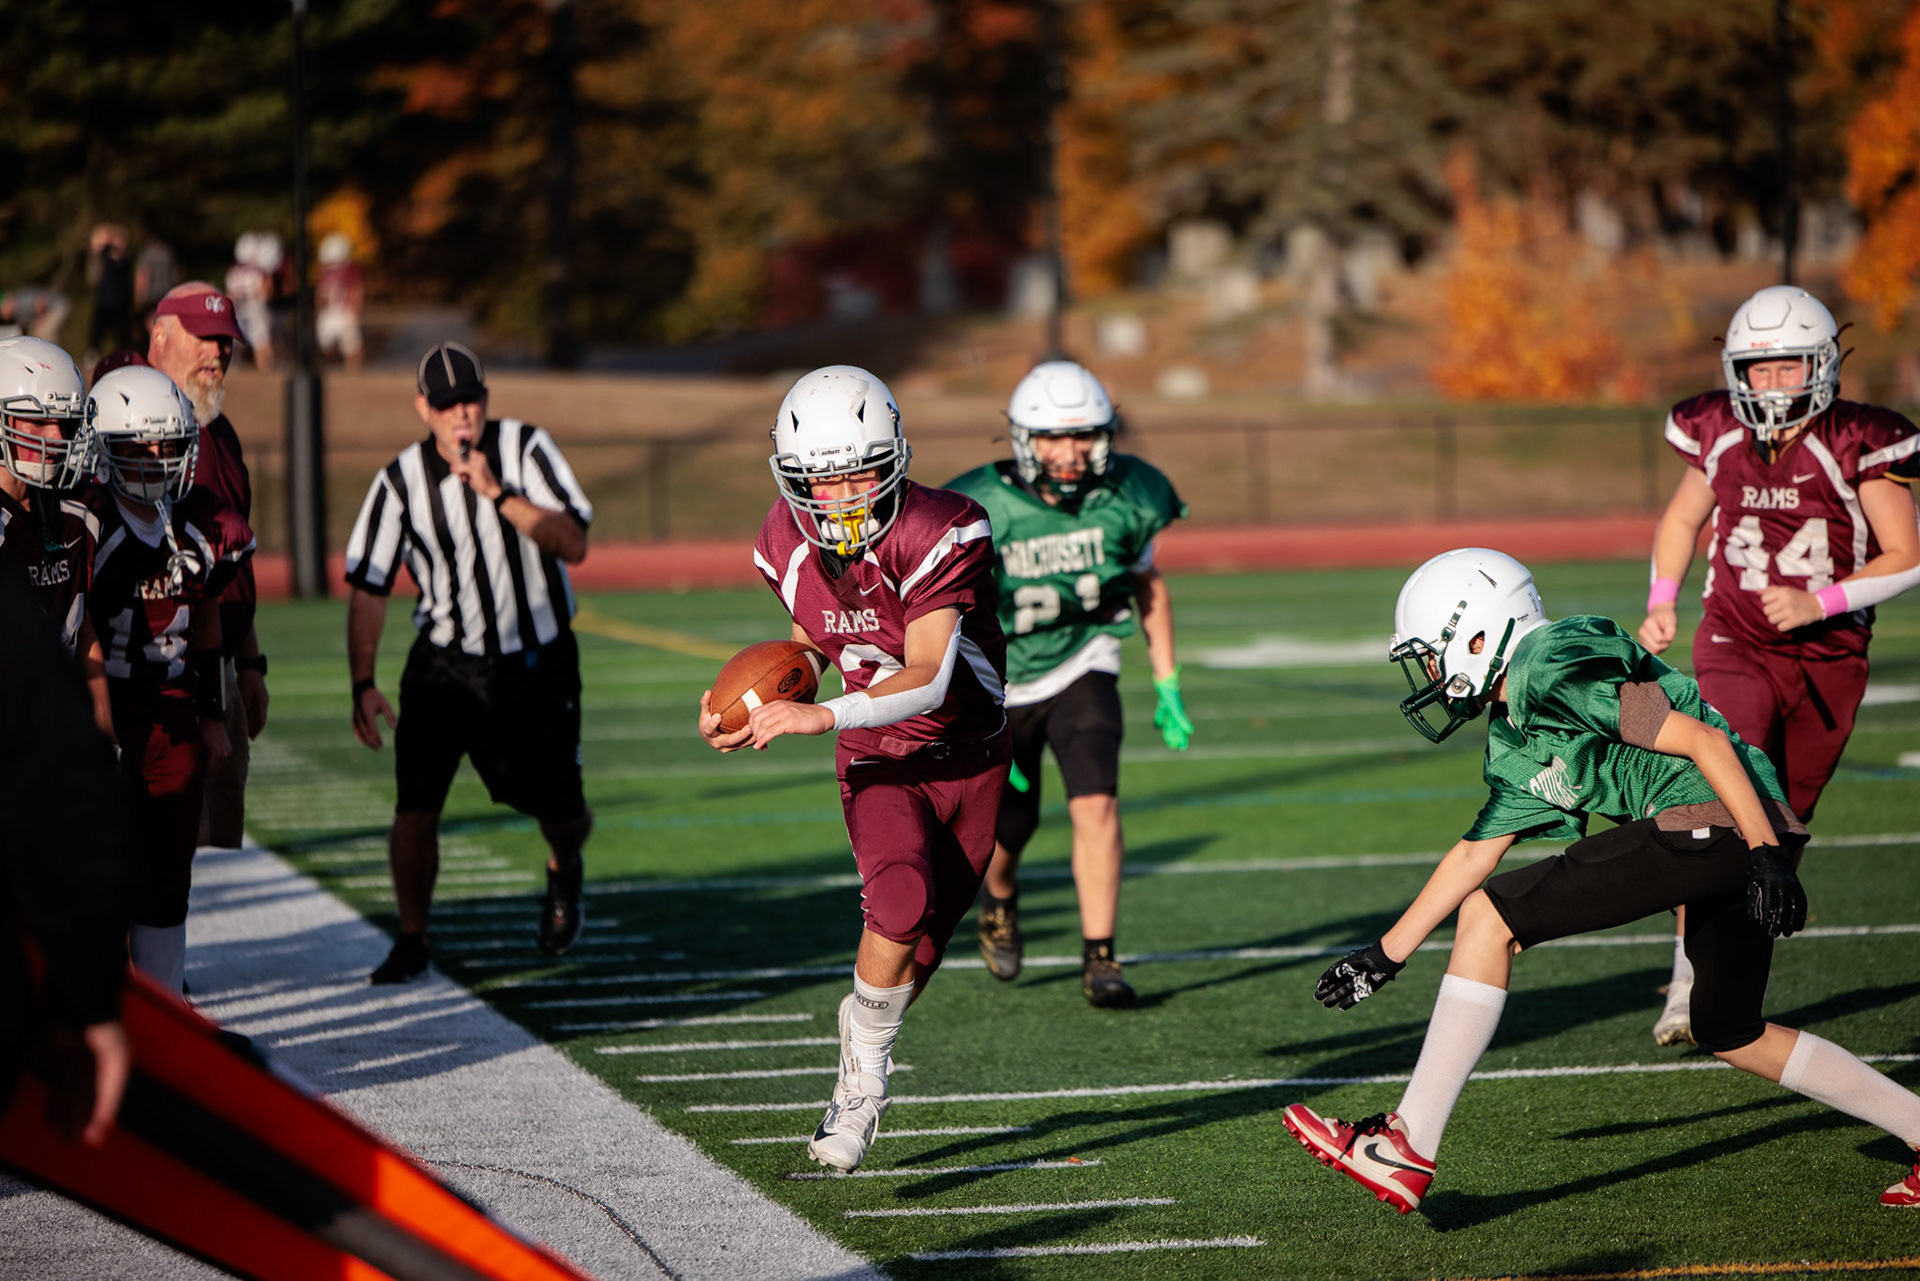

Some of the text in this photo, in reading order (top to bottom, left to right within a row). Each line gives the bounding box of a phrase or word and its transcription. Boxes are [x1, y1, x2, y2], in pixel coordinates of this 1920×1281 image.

[1740, 485, 1800, 509] RAMS
[1724, 515, 1835, 593] 44
[28, 559, 71, 586] RAMS
[821, 608, 880, 634] RAMS
